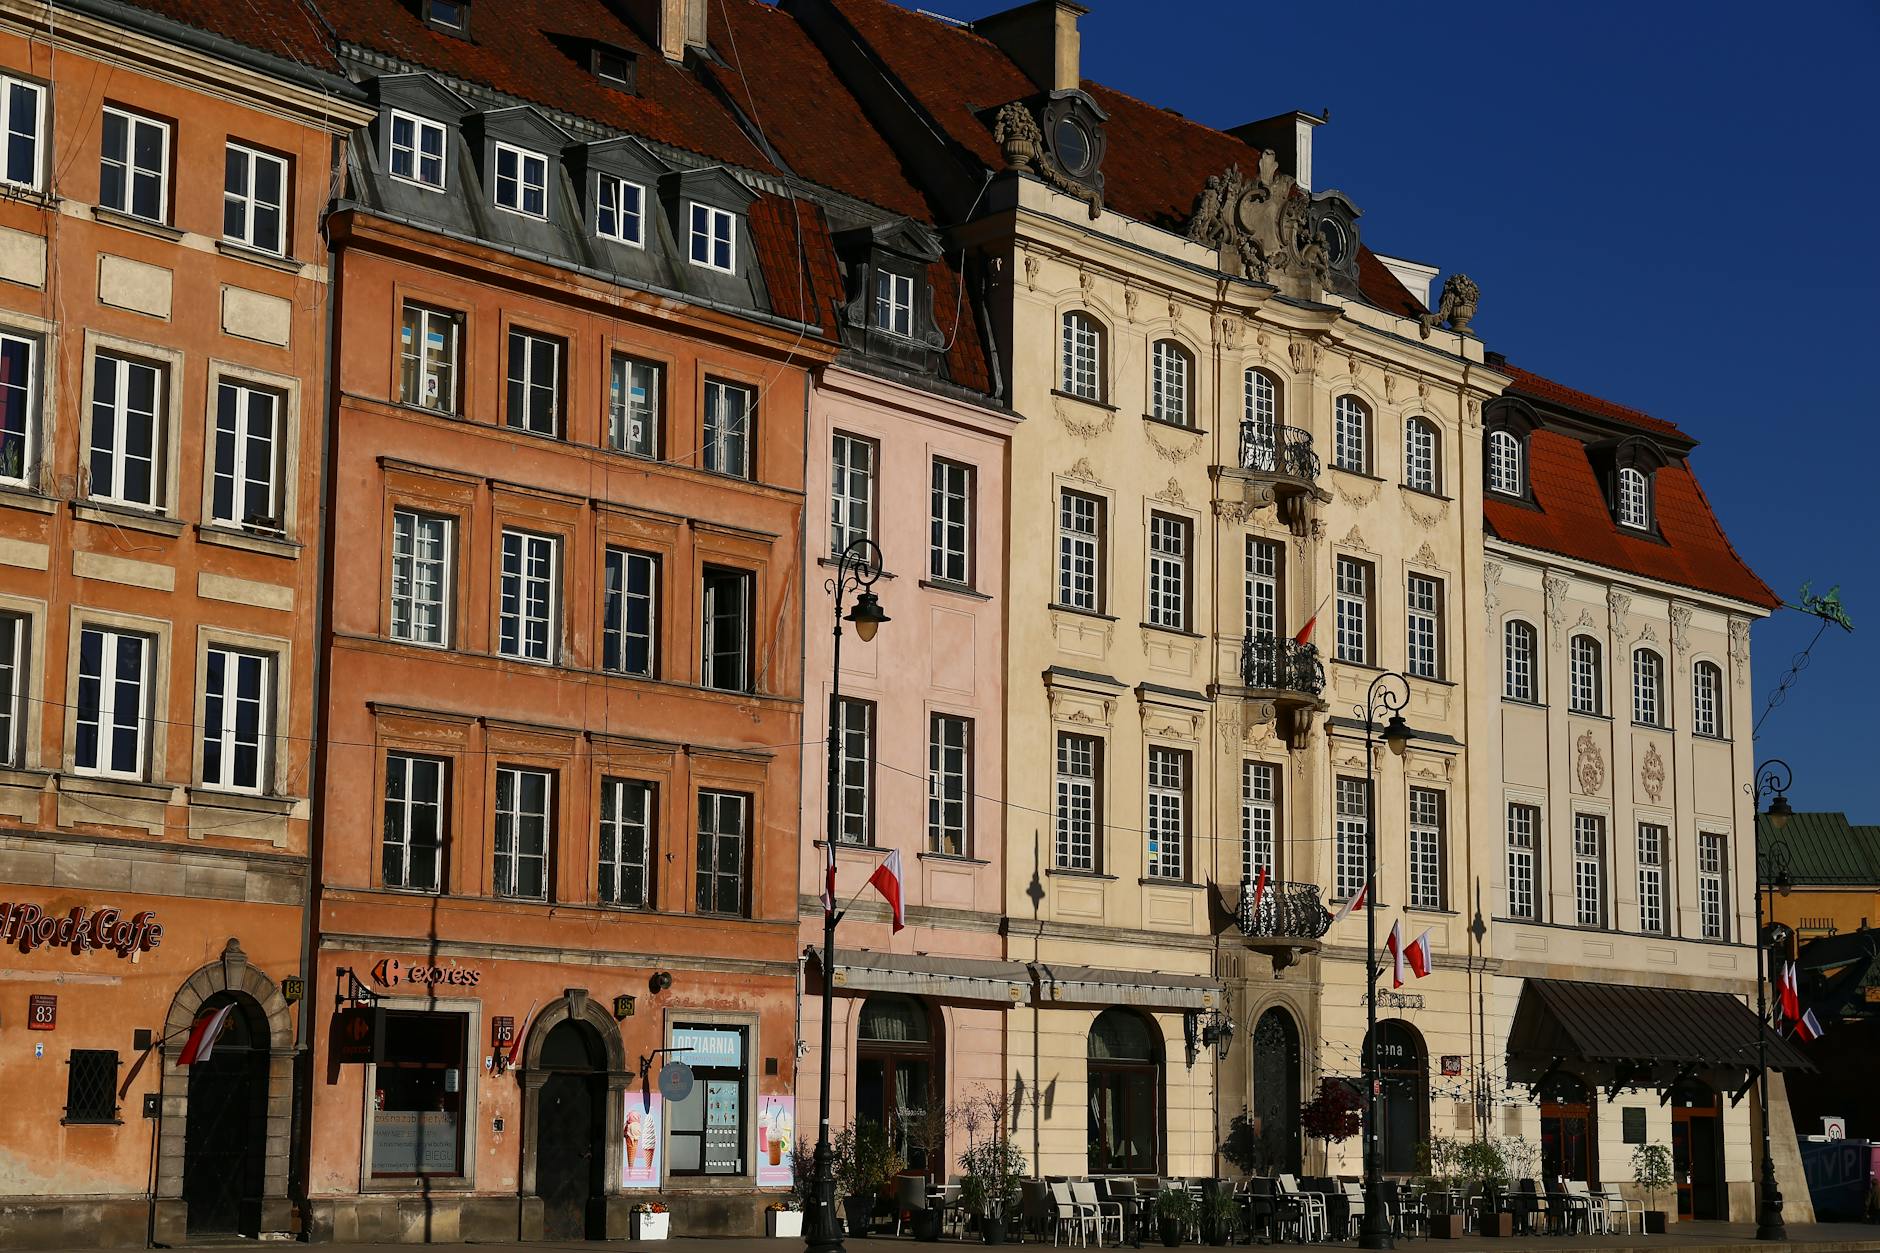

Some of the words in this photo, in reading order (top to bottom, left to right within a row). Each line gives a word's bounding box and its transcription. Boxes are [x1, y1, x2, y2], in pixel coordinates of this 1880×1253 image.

[16, 902, 92, 950] Rock
[96, 908, 163, 953] Cafe
[411, 964, 481, 987] express
[288, 980, 302, 994] 83
[620, 999, 632, 1010] 85
[36, 1006, 53, 1023] 83
[497, 1026, 511, 1041] 85
